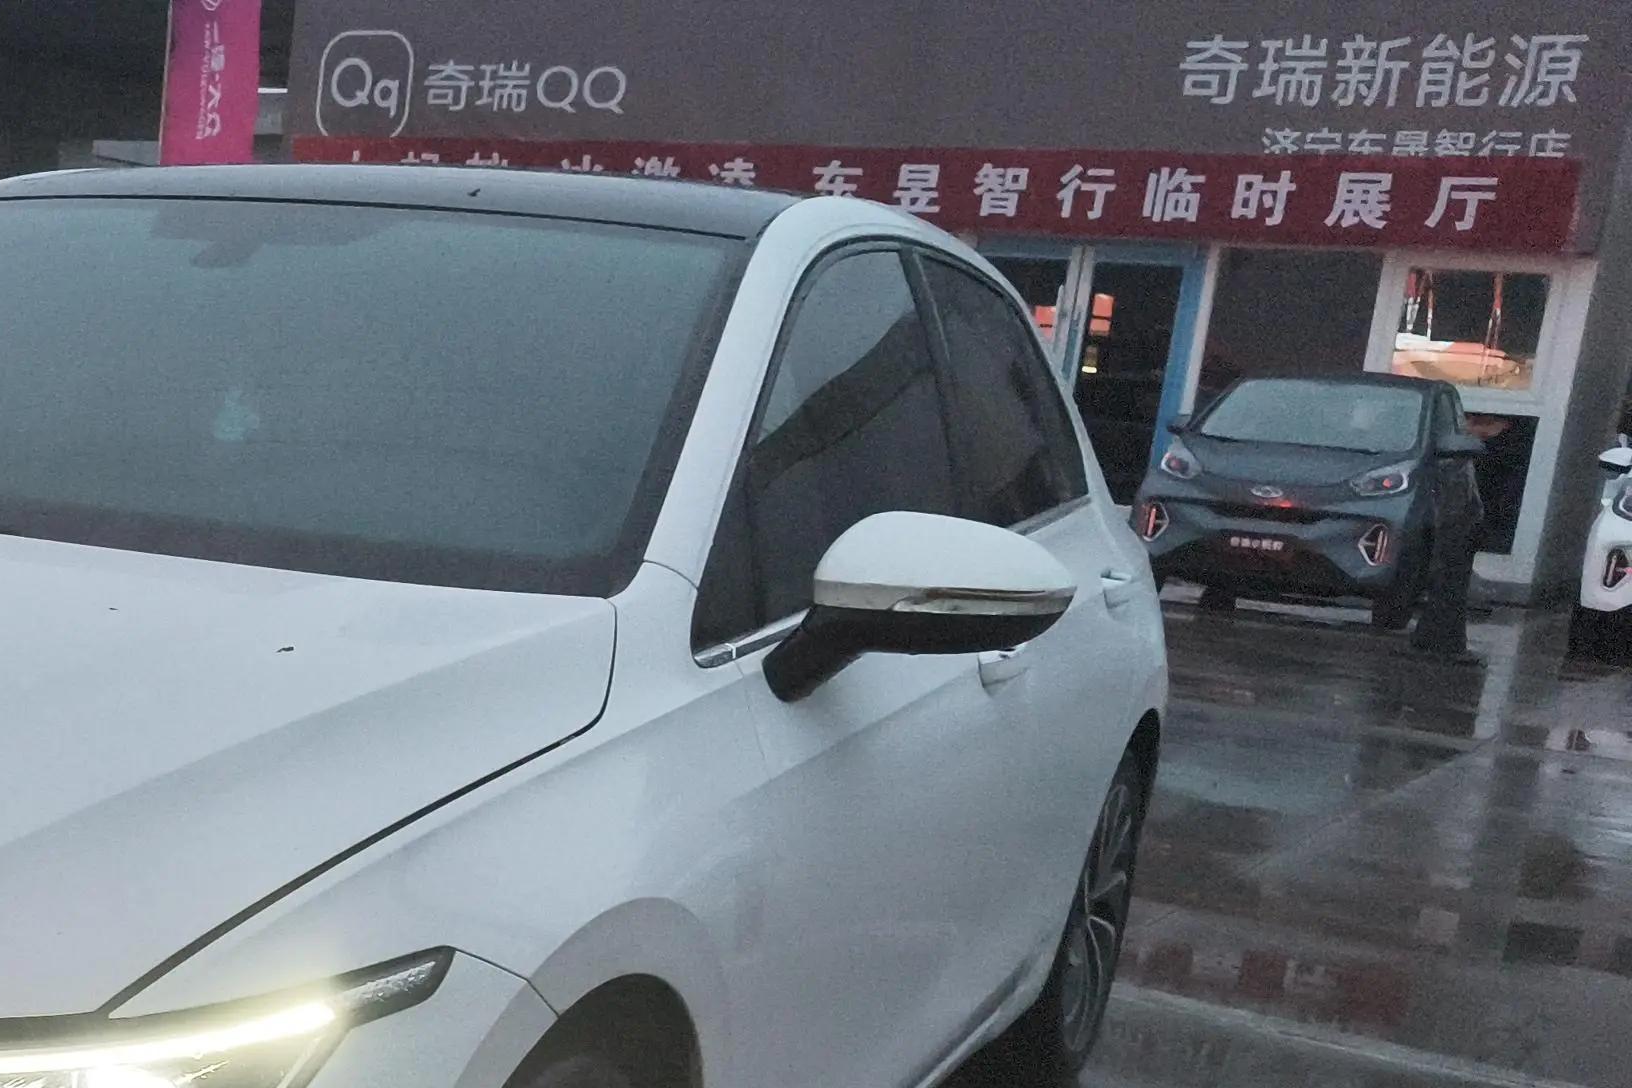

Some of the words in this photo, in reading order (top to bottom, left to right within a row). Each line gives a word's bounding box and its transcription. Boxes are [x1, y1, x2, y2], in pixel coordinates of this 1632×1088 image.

[330, 57, 400, 118] Qq
[423, 59, 627, 114] 奇瑞QQ
[1179, 33, 1590, 108] 奇瑞新能源
